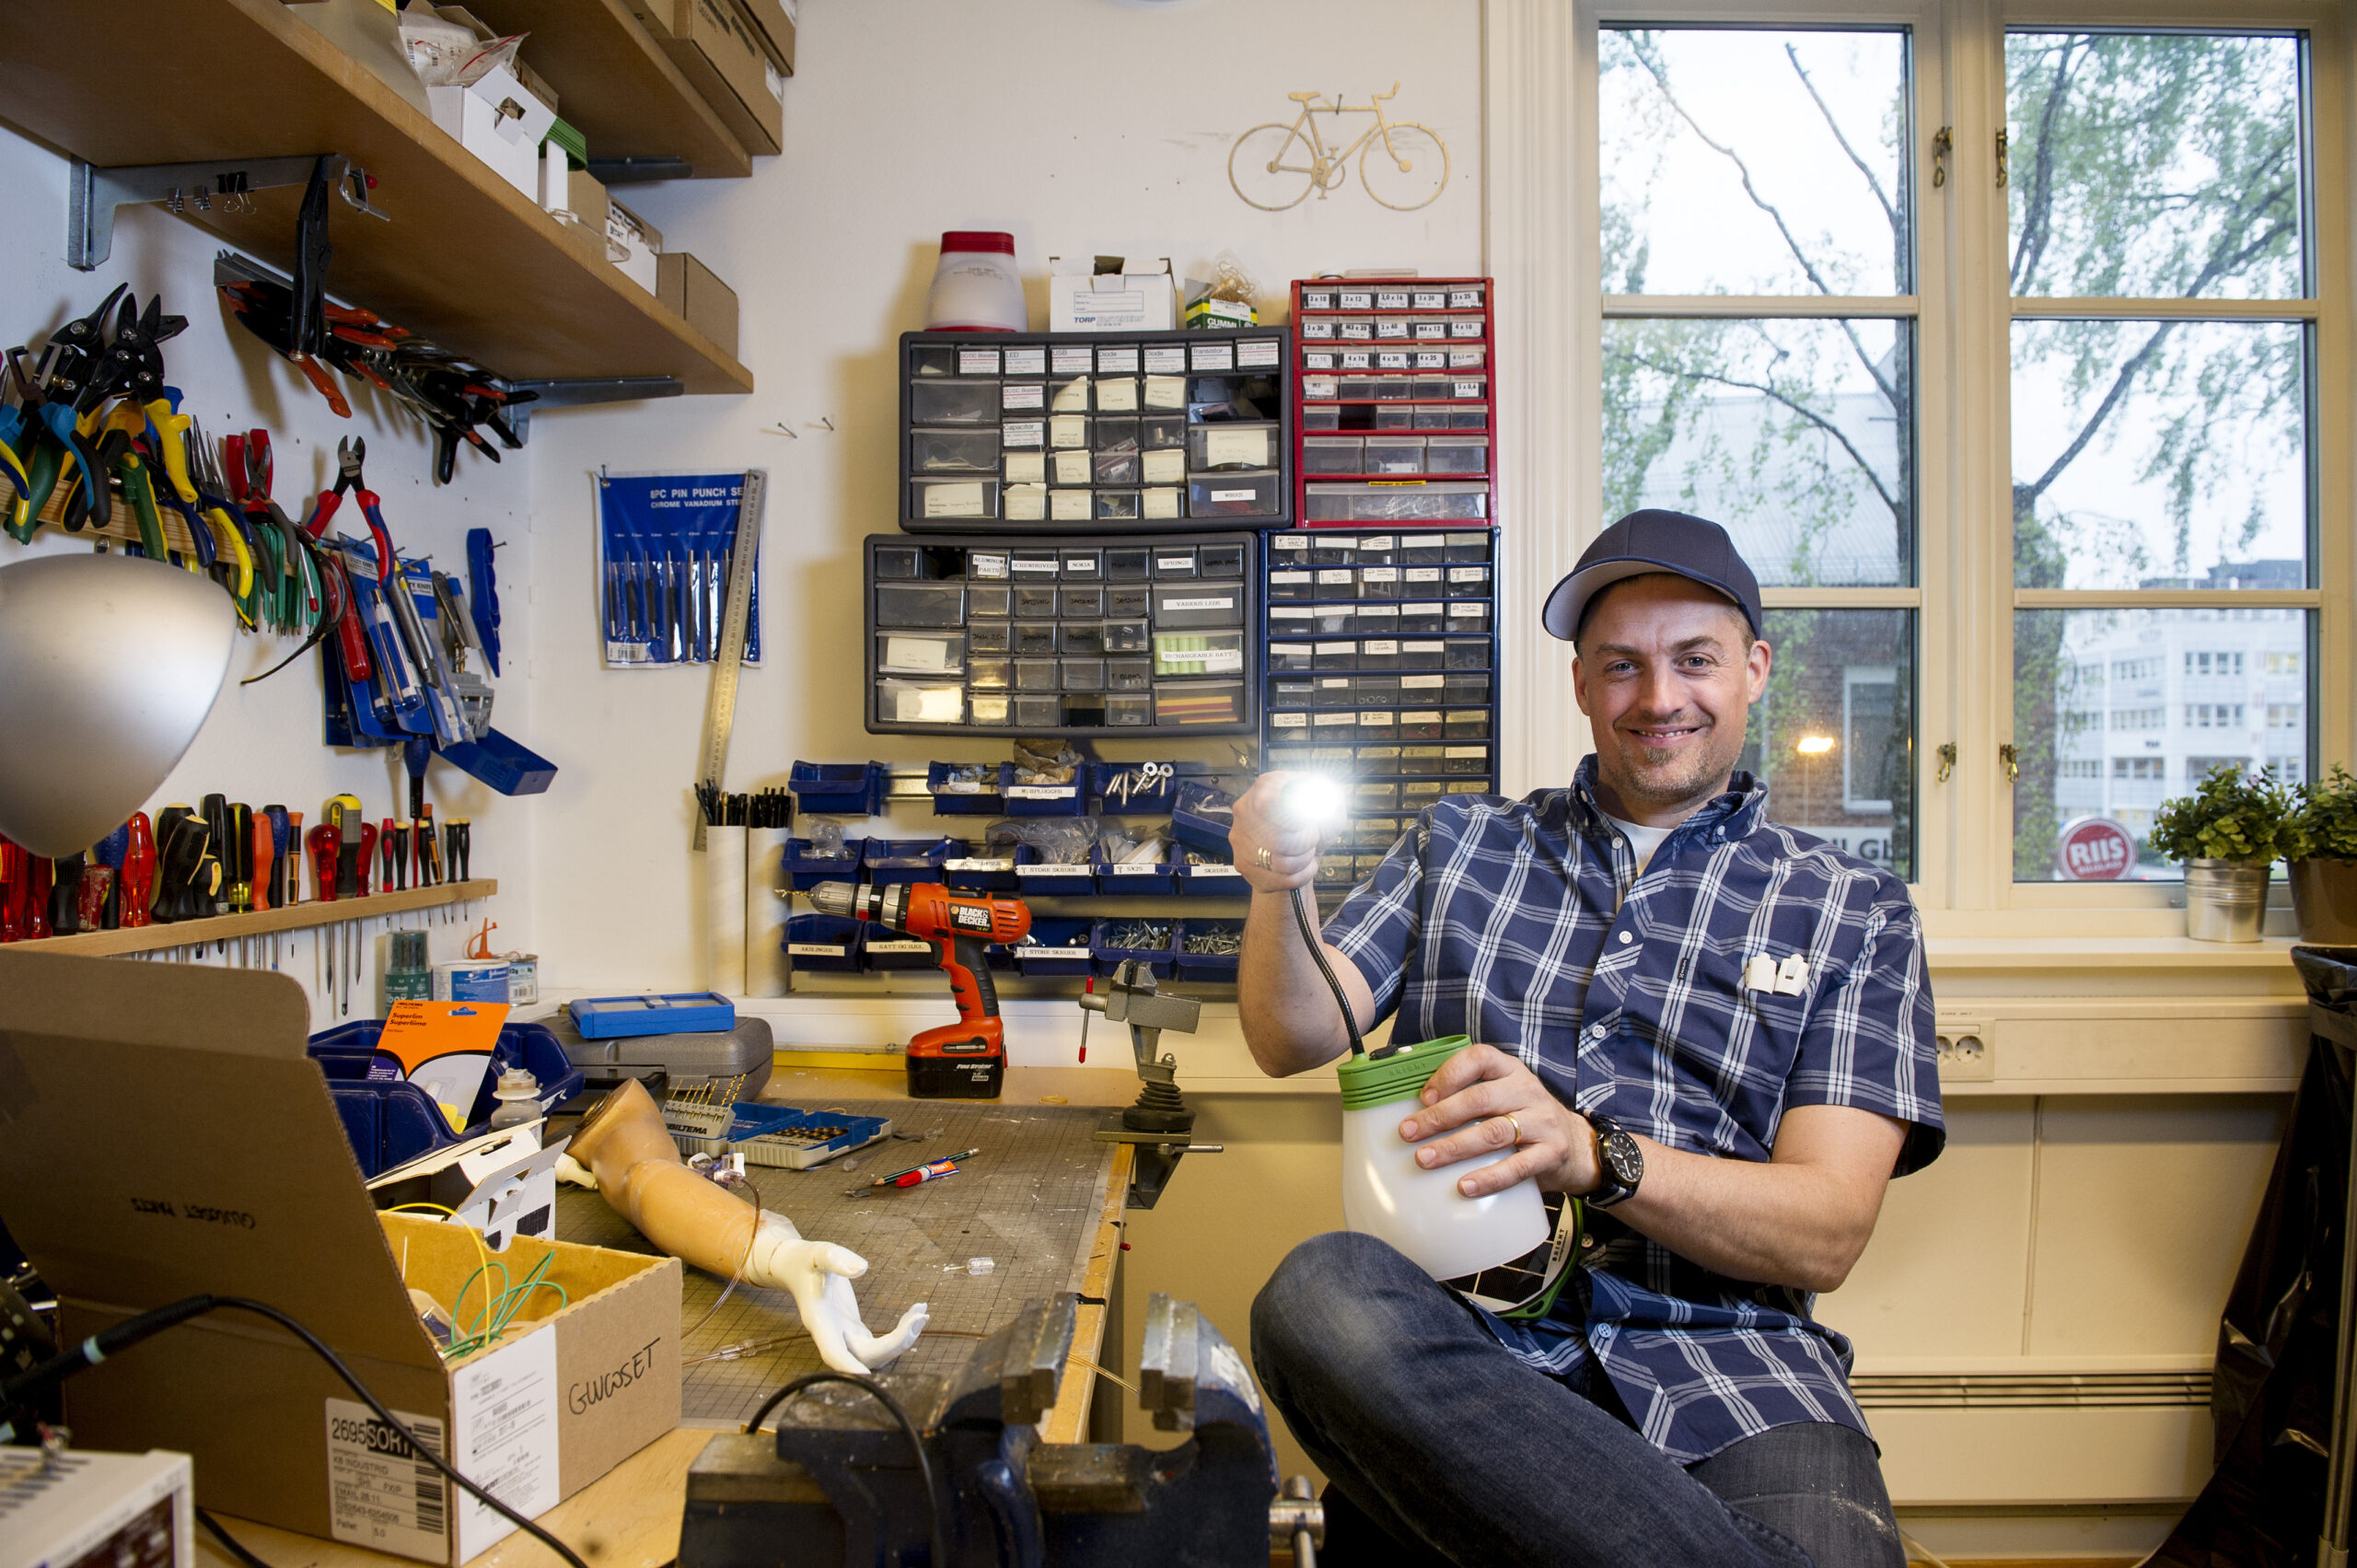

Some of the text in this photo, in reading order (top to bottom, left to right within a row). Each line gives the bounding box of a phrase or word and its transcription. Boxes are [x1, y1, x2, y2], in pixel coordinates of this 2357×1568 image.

[1074, 316, 1096, 324] TORP
[1207, 317, 1237, 328] GUMMI
[1004, 424, 1034, 432] Capacitor
[650, 487, 744, 499] 8PC PIN PUNCH SE
[2069, 837, 2125, 866] RIIS
[958, 915, 988, 927] DECKER
[667, 1123, 707, 1134] BILTEMA
[1552, 1228, 1564, 1261] BRIGHT
